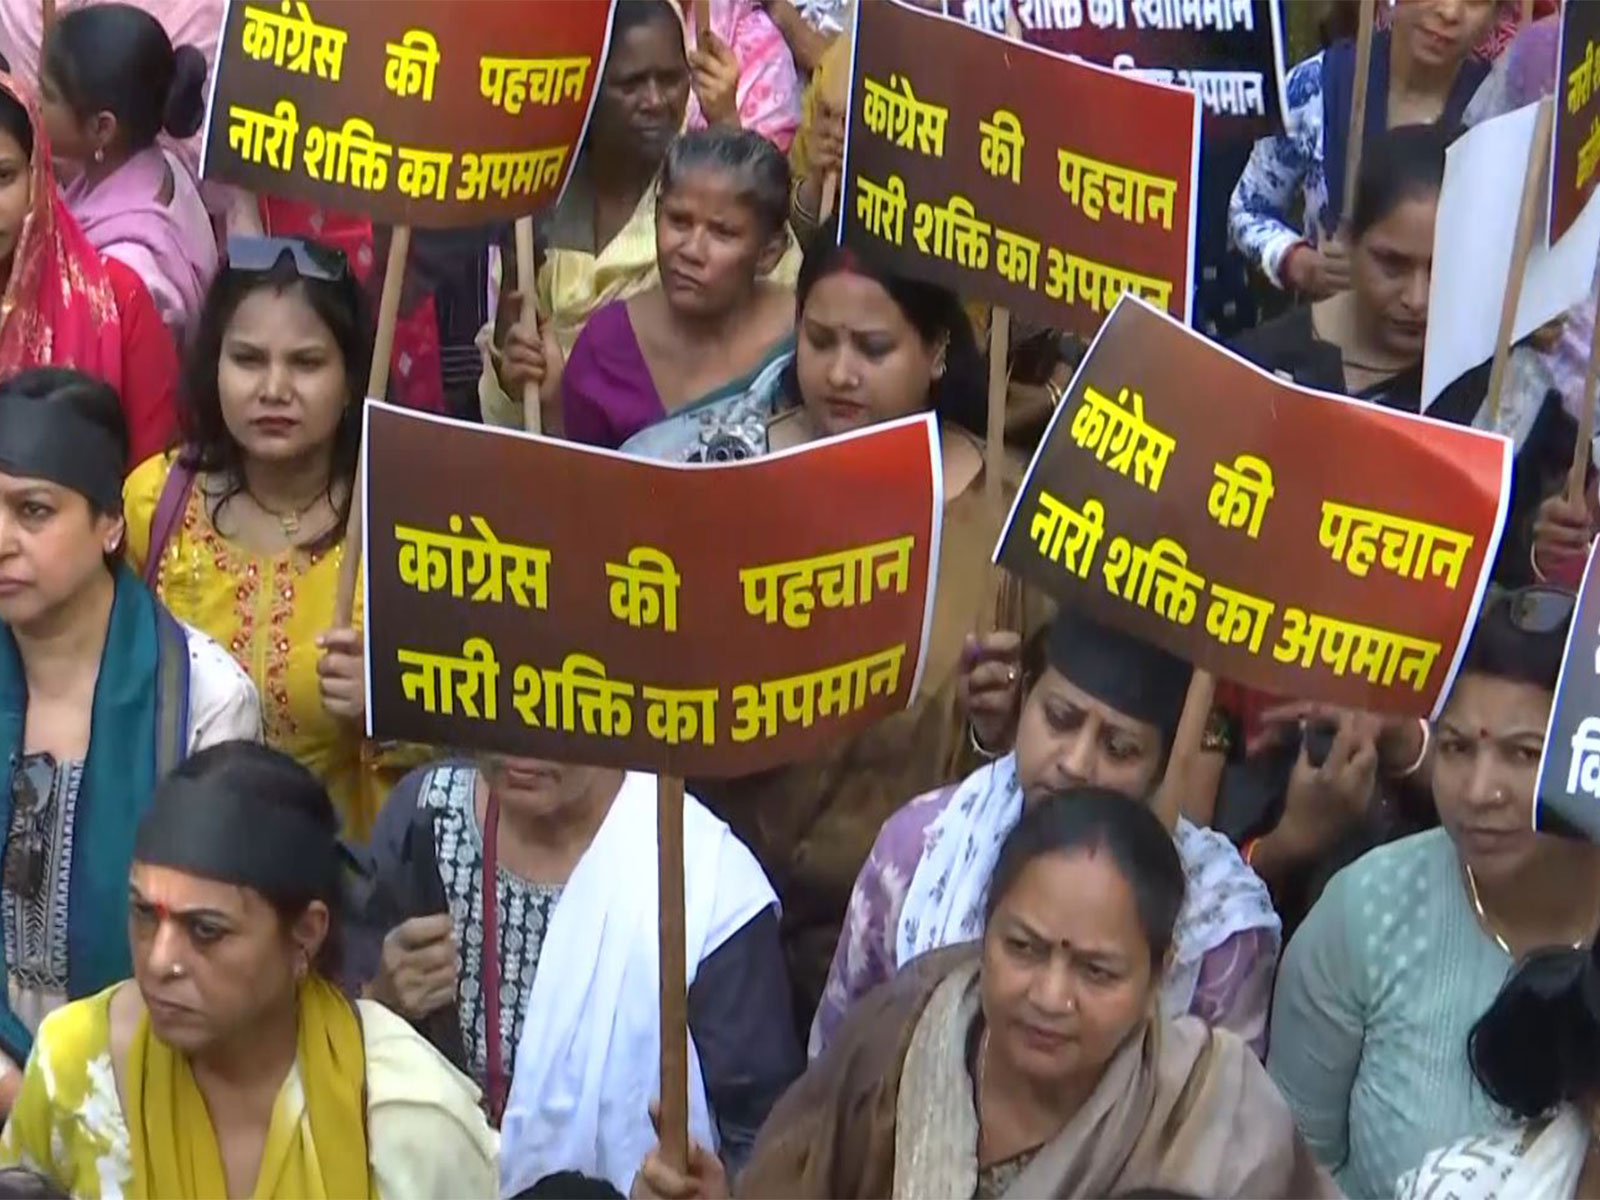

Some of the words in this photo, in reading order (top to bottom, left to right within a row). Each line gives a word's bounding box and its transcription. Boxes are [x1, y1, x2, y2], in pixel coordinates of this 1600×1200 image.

[241, 0, 349, 82] कांग्रेस
[382, 26, 440, 102] की
[480, 53, 592, 115] पहचान
[229, 100, 300, 171] नारी
[303, 117, 393, 192] शक्ति
[397, 145, 454, 201] का
[455, 145, 570, 202] अपमान
[863, 74, 949, 155] कांग्रेस
[979, 110, 1026, 183] की
[1058, 148, 1177, 230] पहचान
[856, 175, 908, 245] नारी
[912, 196, 992, 270] शक्ति
[994, 228, 1041, 289] का
[1070, 386, 1178, 493] कांग्रेस
[1207, 454, 1275, 540] की
[1318, 499, 1475, 589] पहचान
[394, 514, 551, 610] कांग्रेस
[605, 546, 681, 632] की
[739, 535, 915, 629] पहचान
[1030, 491, 1105, 580] नारी
[1102, 537, 1206, 624] शक्ति
[1205, 582, 1276, 655] का
[1272, 607, 1442, 692] अपमान
[397, 637, 501, 720] नारी
[512, 653, 635, 737] शक्ति
[642, 684, 720, 746] का
[730, 643, 907, 744] अपमान
